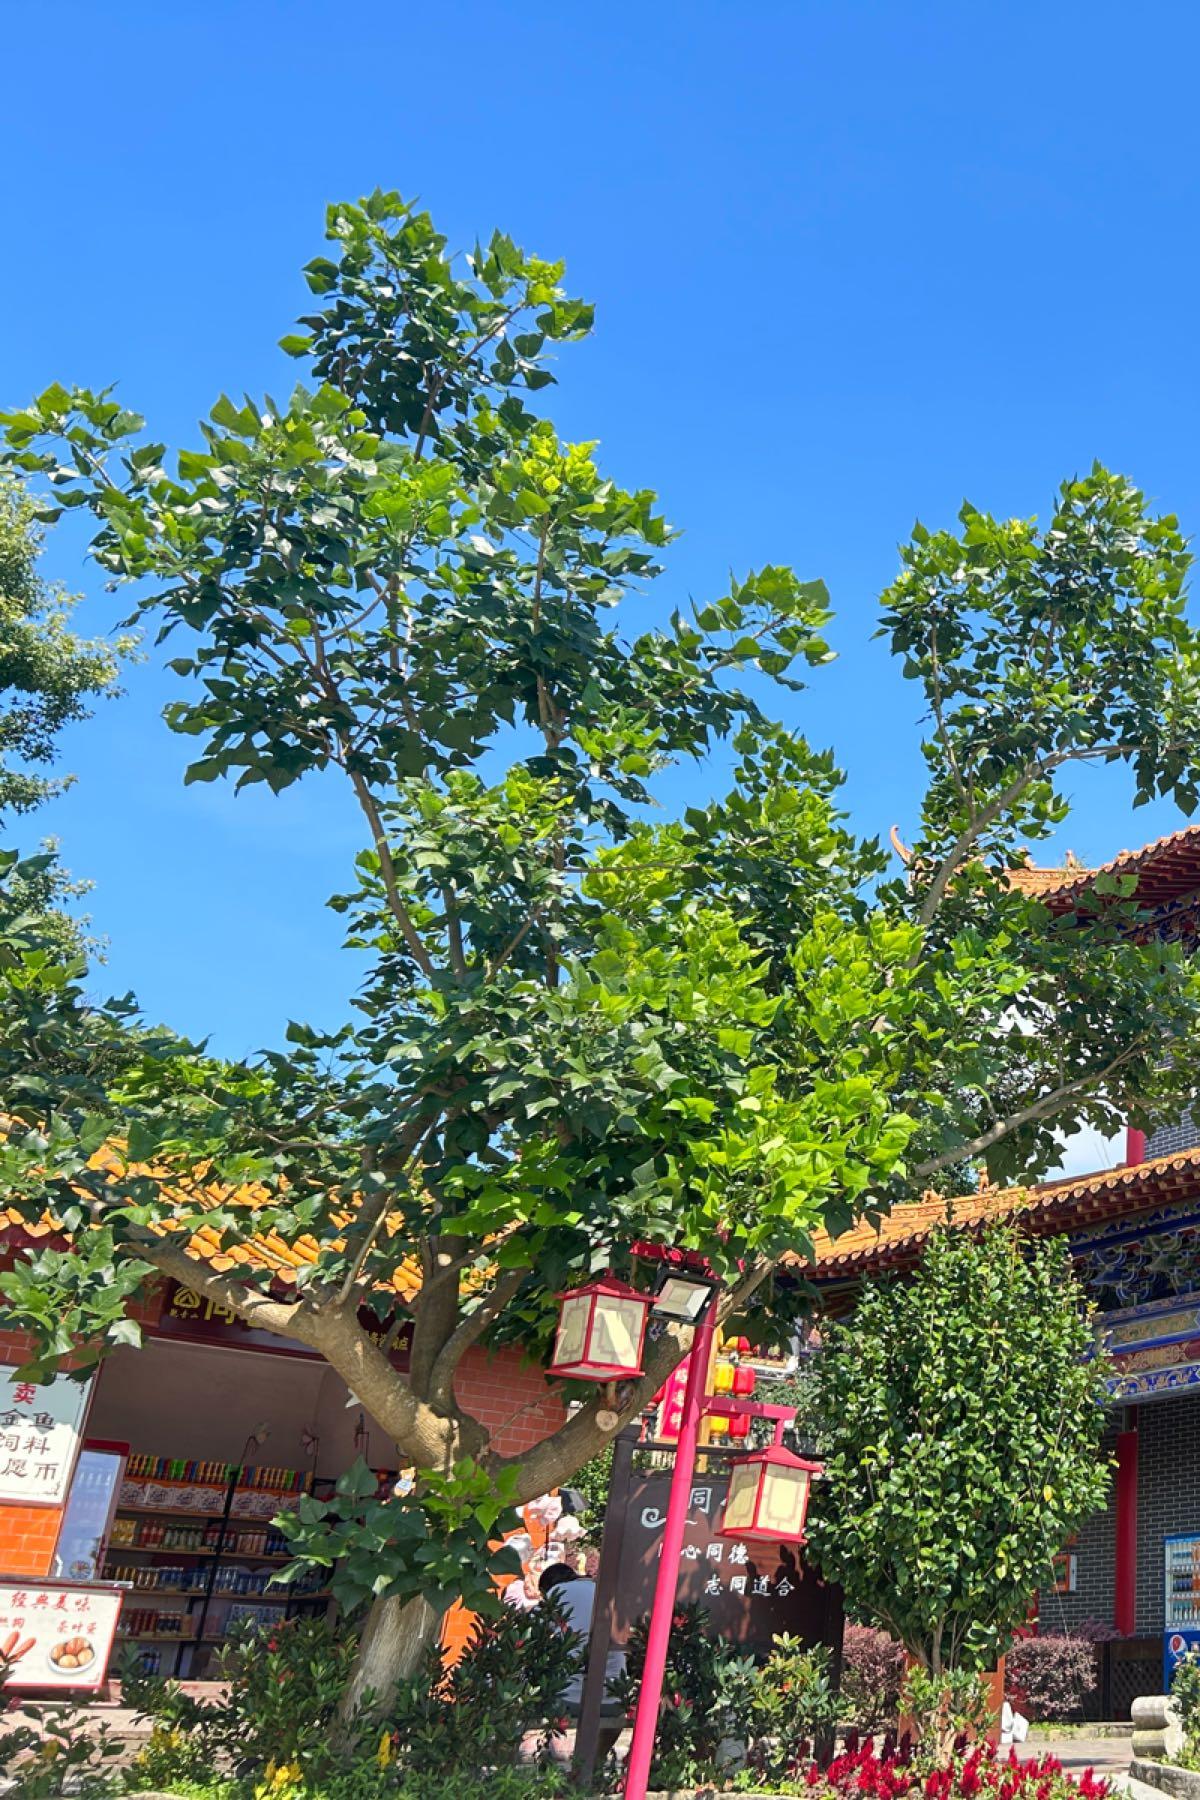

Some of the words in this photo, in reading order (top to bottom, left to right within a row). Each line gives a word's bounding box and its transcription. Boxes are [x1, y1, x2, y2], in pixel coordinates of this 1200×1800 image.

[12, 1383, 36, 1405] 卖
[0, 1408, 55, 1430] 金鱼
[658, 1542, 749, 1564] 心同德
[704, 1574, 795, 1597] 志同道合
